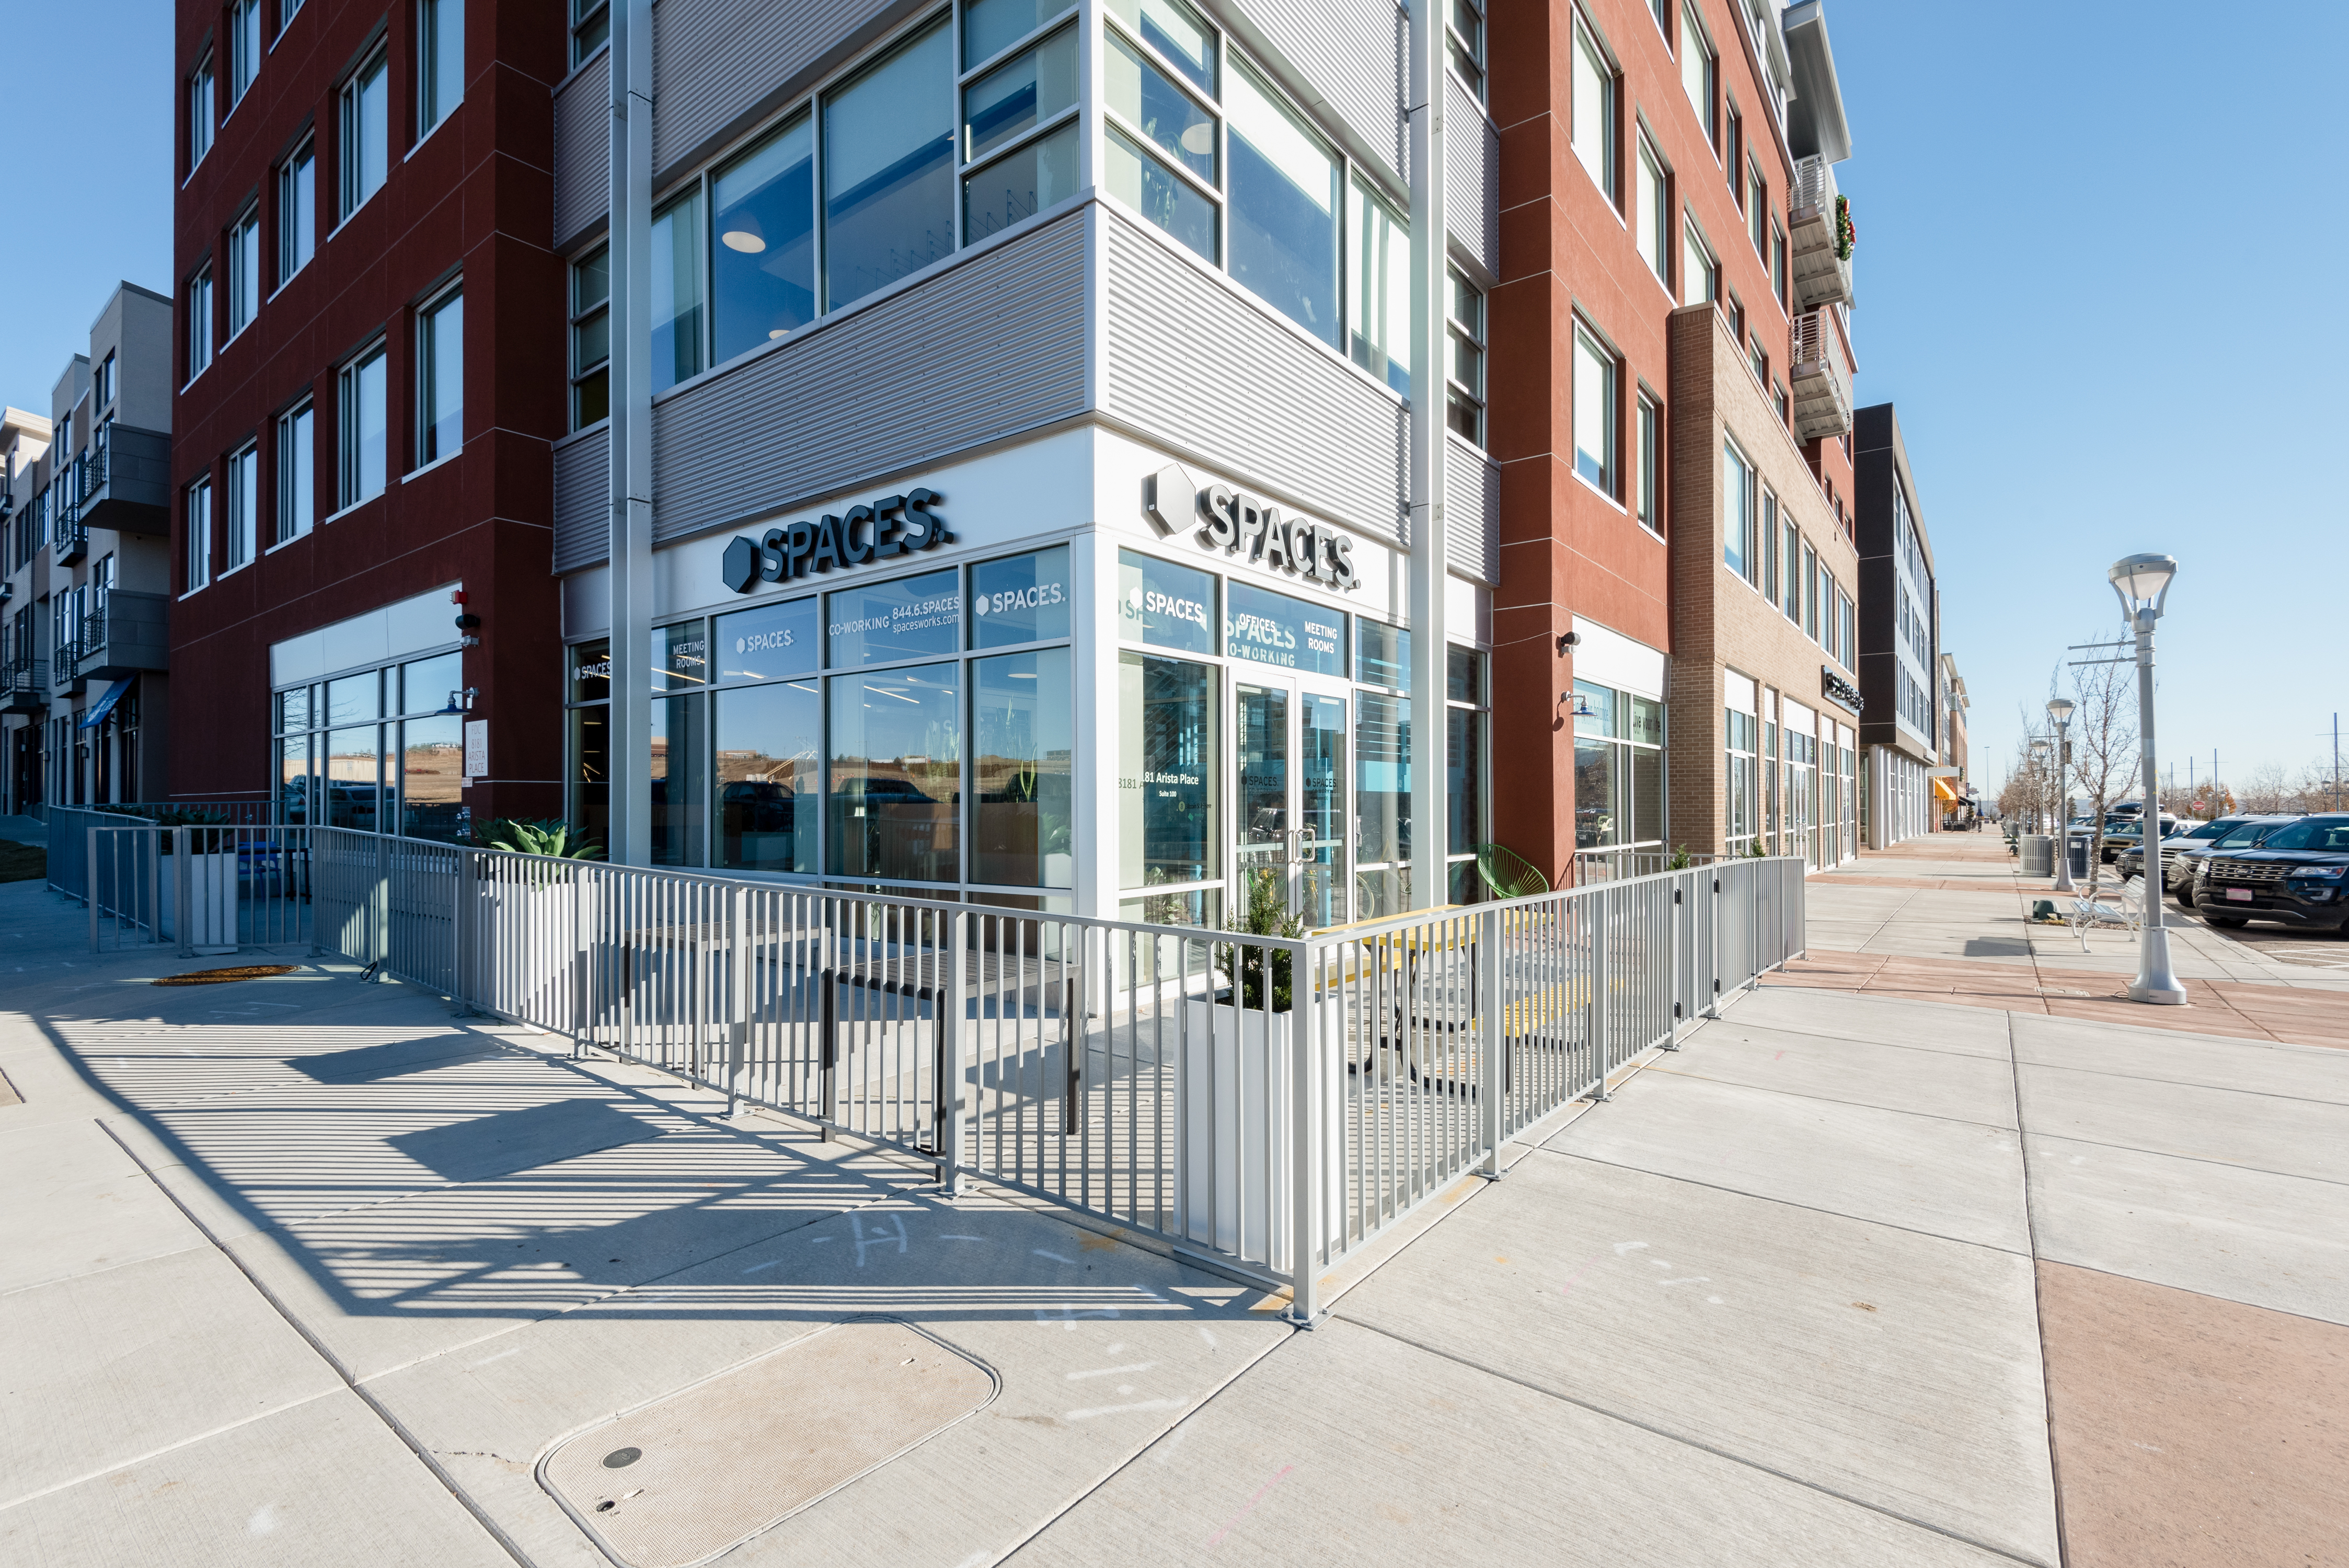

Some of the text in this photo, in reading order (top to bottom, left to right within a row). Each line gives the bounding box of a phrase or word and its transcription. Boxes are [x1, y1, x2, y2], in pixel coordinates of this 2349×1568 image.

[761, 487, 954, 584] SPACES.
[1196, 483, 1361, 590] SPACES.
[993, 583, 1066, 613] SPACES.
[1146, 591, 1206, 623] SPACES.
[892, 596, 959, 620] 844.6.SPACES
[828, 616, 890, 636] CO-WORKING
[893, 614, 959, 635] spacesworks.com
[1239, 613, 1276, 633] OFFICES
[1304, 620, 1338, 640] MEETING
[673, 640, 705, 655] MEETING
[747, 629, 794, 652] SPACES.
[1308, 637, 1334, 654] ROOMS
[581, 661, 610, 679] SPACES
[676, 655, 701, 669] ROOMS
[471, 724, 481, 735] FDC
[471, 738, 482, 749] 8181
[468, 751, 486, 762] ARISTA
[469, 763, 484, 774] PLACE
[1156, 772, 1178, 784] Arista
[1180, 774, 1199, 785] Place
[1249, 776, 1279, 787] SPACES.
